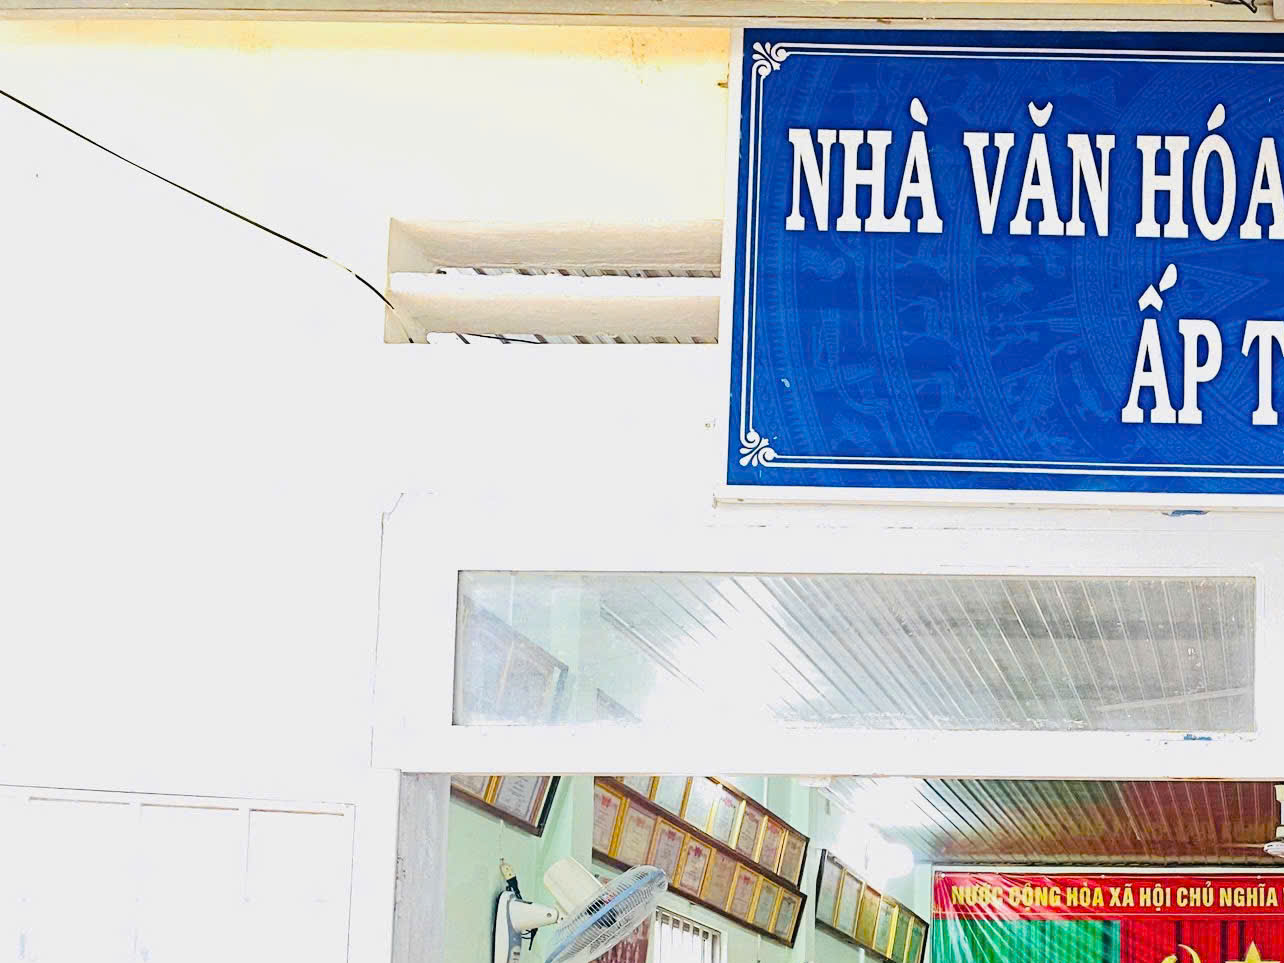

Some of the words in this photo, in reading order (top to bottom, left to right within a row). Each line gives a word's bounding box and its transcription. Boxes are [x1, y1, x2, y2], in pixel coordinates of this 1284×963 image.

[786, 97, 943, 233] NHÀ
[963, 101, 1116, 237] VĂN
[1121, 263, 1223, 424] ẤP
[1009, 882, 1061, 911] CỘNG
[1109, 883, 1135, 907] XÃ
[1139, 883, 1171, 911] HỘI
[1176, 881, 1214, 907] CHỦ
[1219, 883, 1278, 907] NGHĨA
